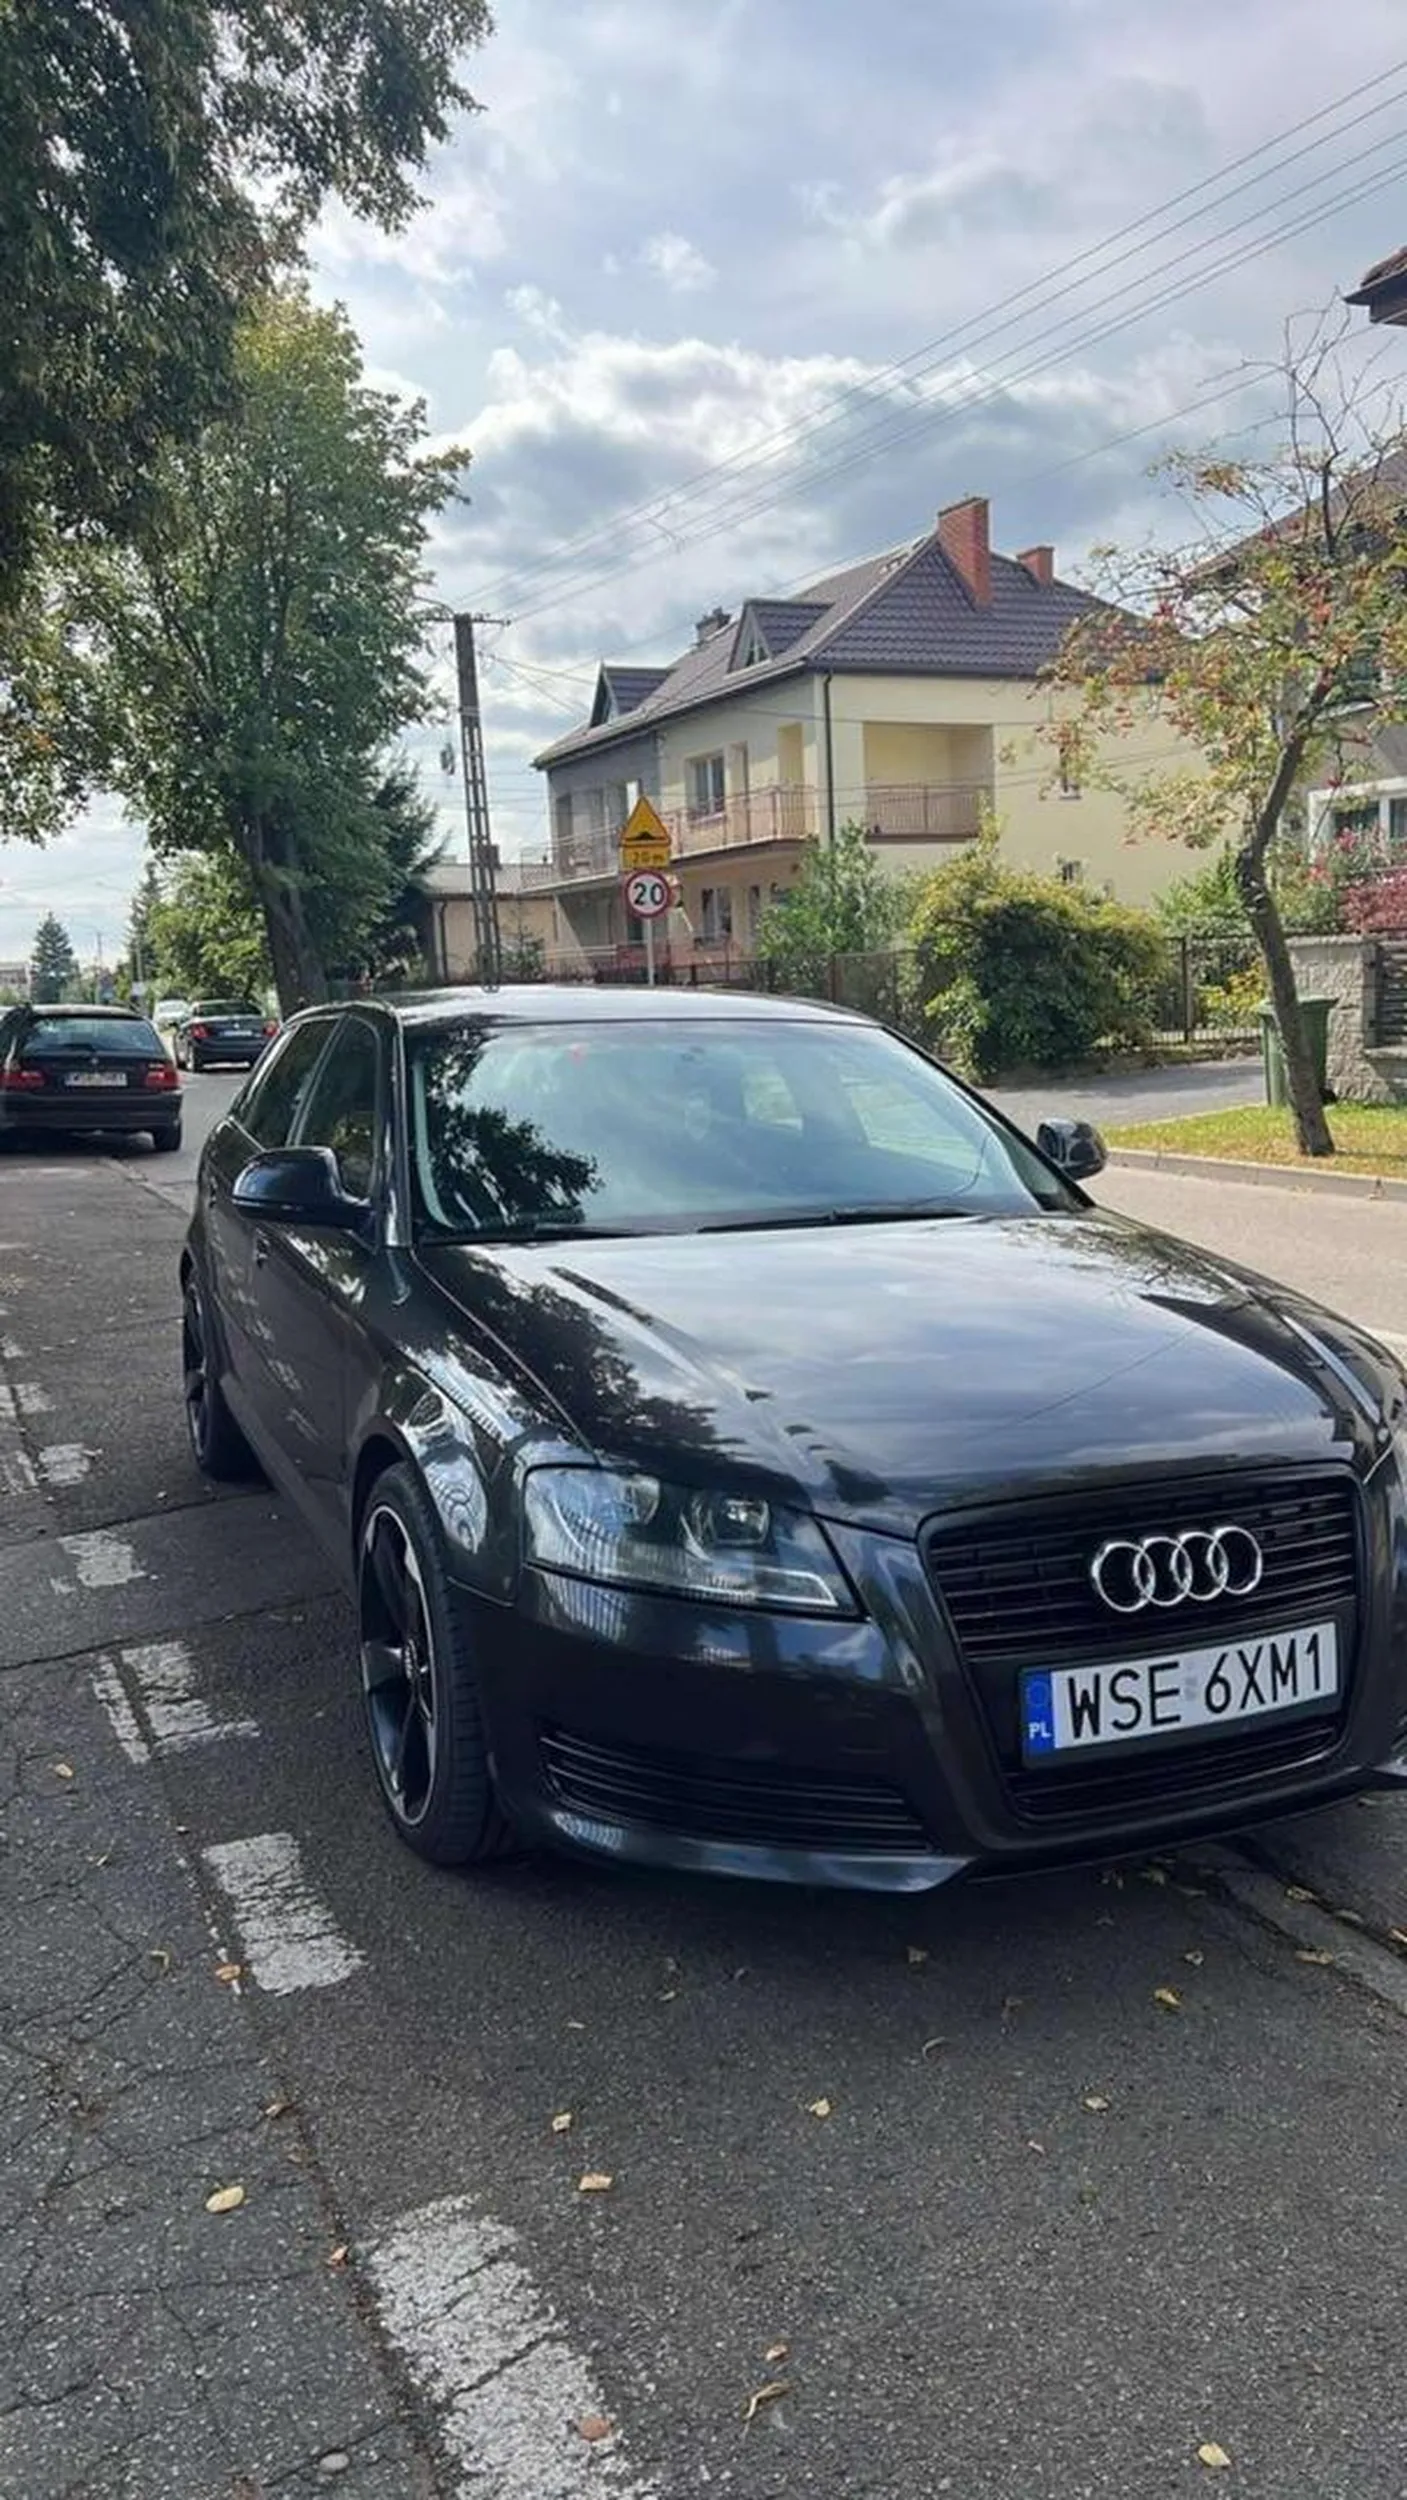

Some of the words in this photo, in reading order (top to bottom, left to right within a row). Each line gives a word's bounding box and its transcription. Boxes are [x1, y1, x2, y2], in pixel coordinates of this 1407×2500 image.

[634, 882, 665, 906] 20
[1068, 1661, 1181, 1739] WSE
[1205, 1632, 1321, 1714] 6XM1
[1029, 1722, 1052, 1739] PL
